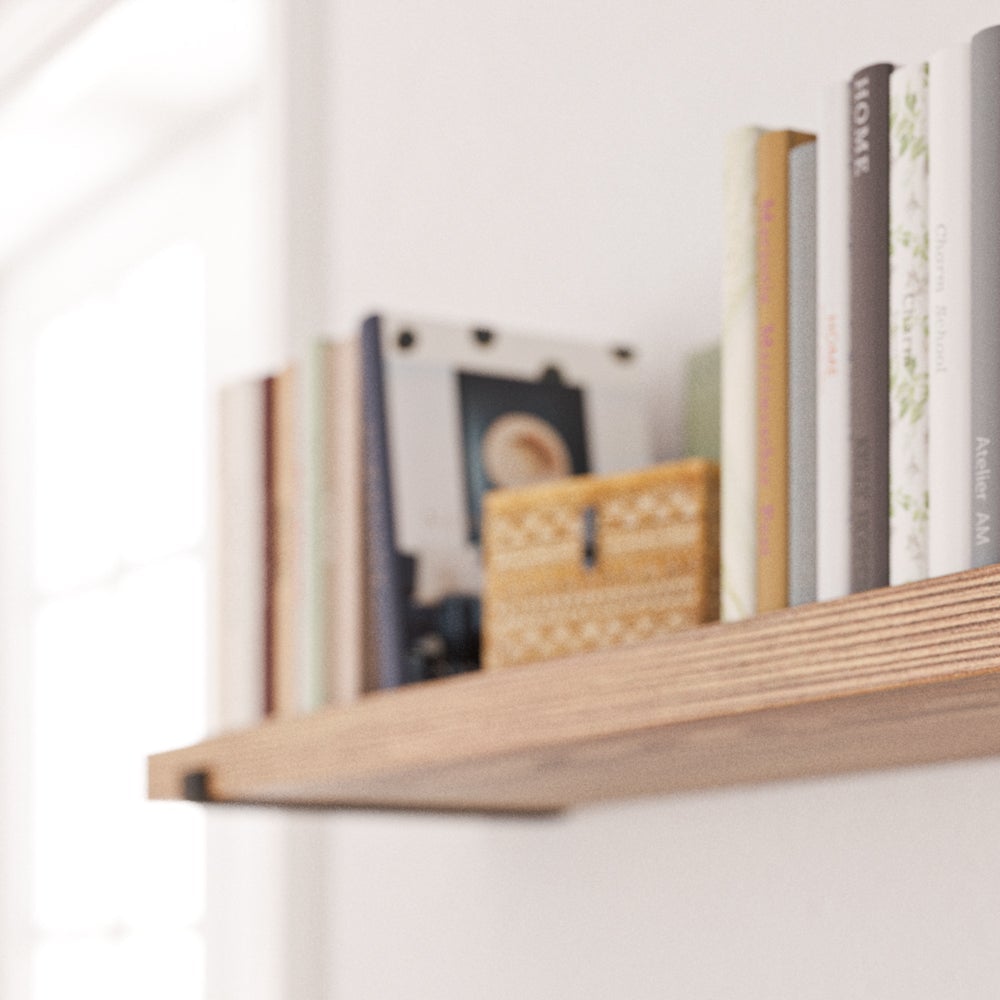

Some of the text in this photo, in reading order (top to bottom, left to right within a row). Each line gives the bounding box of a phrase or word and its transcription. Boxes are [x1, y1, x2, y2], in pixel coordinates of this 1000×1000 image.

[853, 76, 871, 178] HOME
[975, 436, 992, 547] Atelier AM
